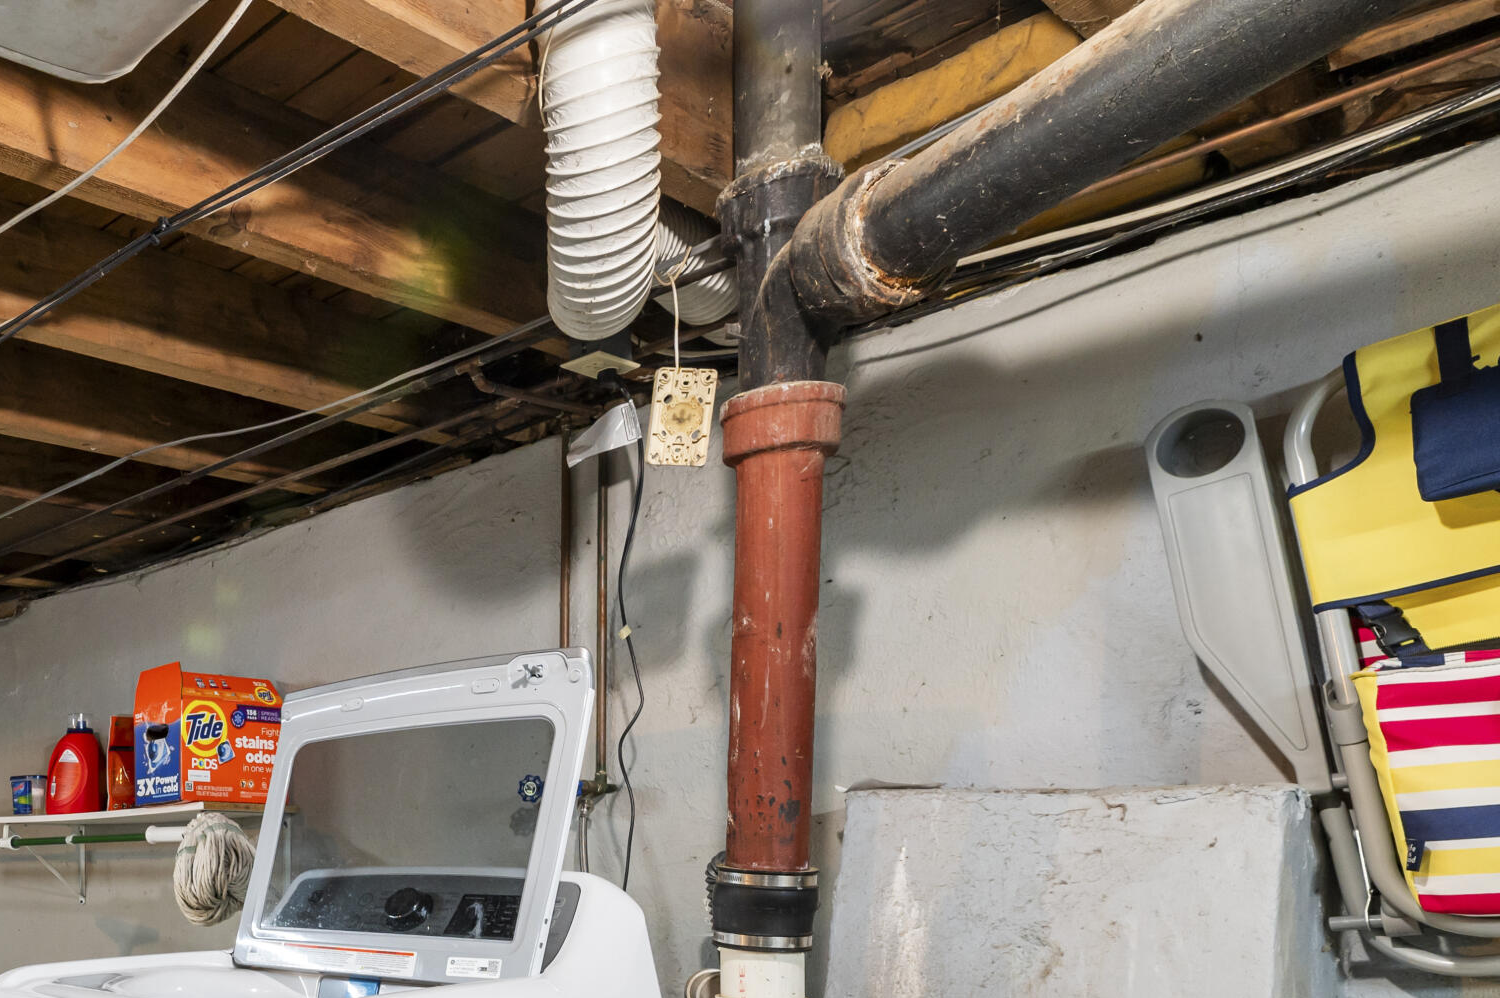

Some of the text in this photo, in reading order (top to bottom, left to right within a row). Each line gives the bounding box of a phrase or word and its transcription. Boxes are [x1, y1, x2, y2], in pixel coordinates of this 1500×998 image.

[186, 712, 224, 746] Tide
[235, 735, 275, 750] stains
[191, 757, 218, 770] PODS
[250, 765, 265, 773] one
[136, 777, 156, 797] 3X
[155, 782, 179, 794] in cold
